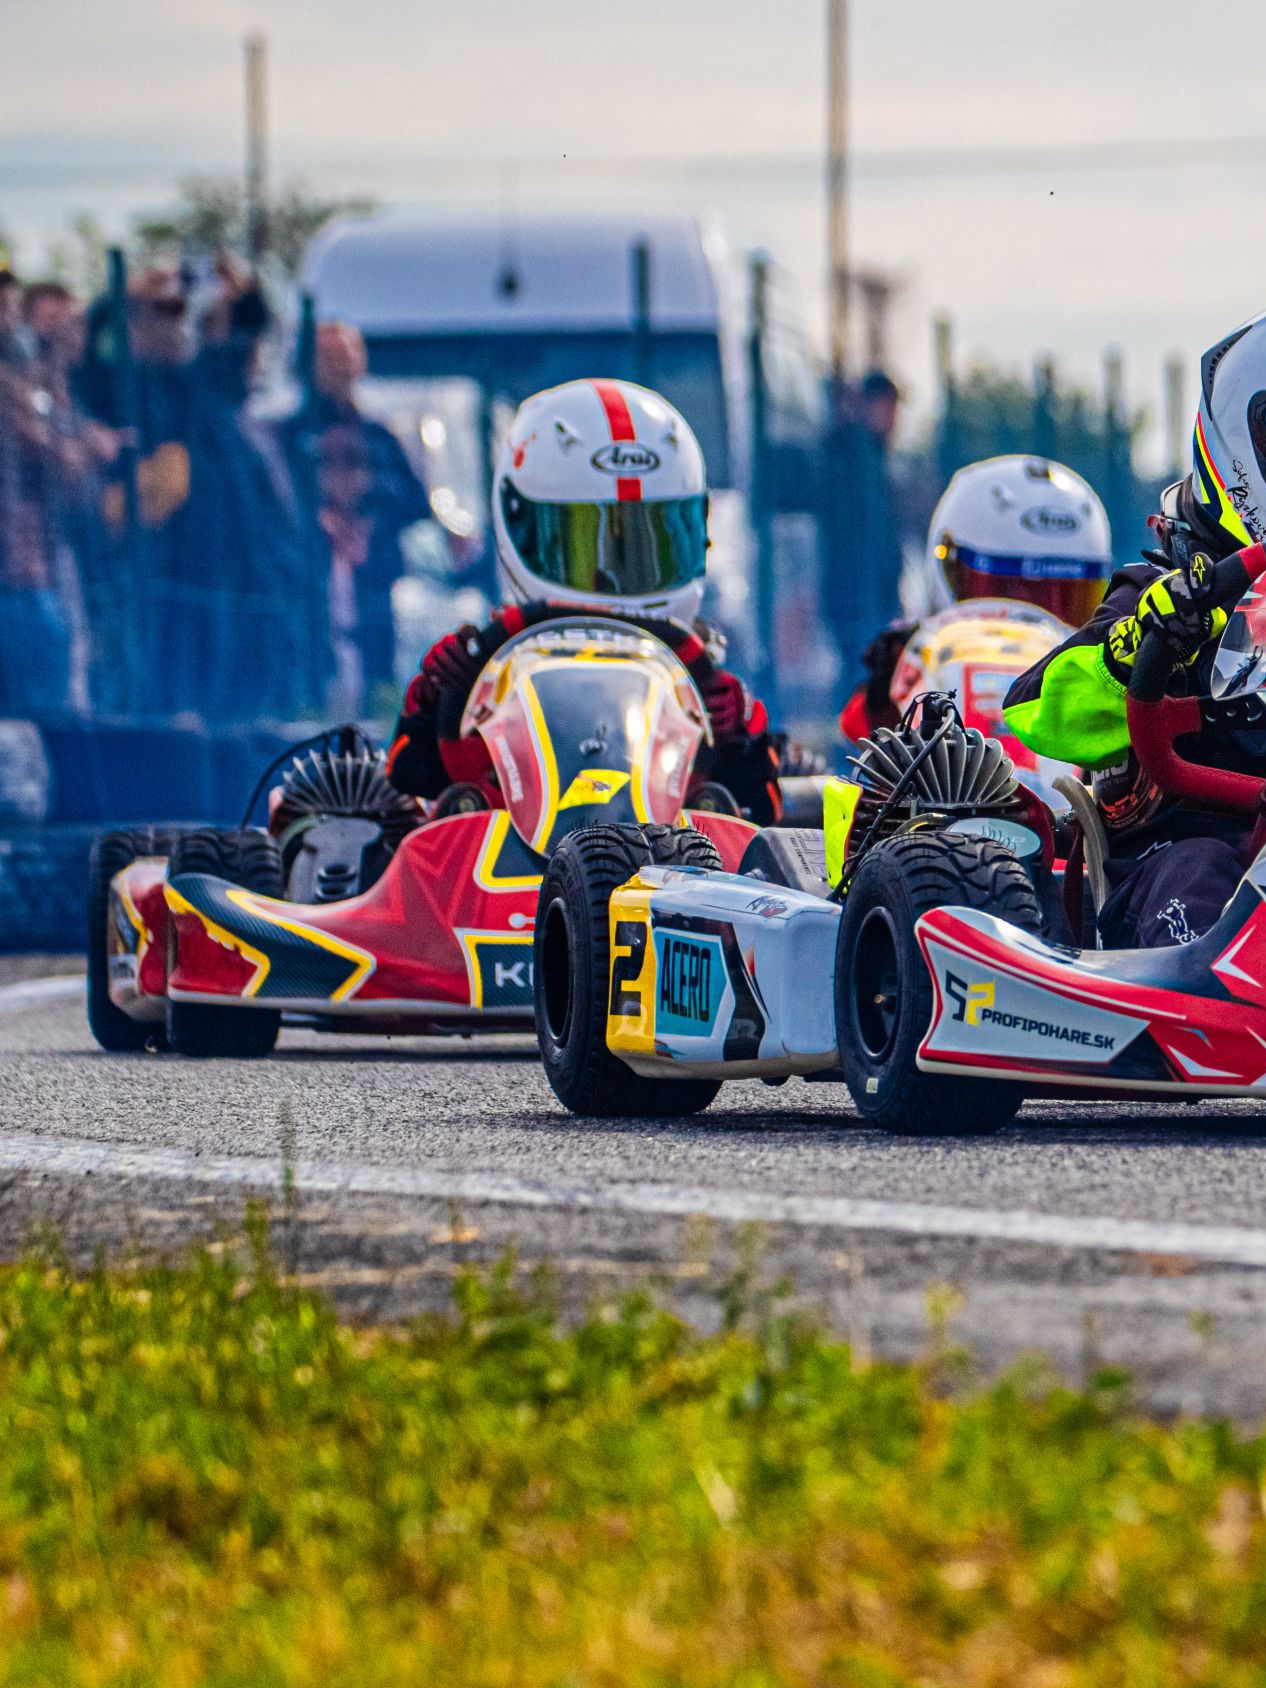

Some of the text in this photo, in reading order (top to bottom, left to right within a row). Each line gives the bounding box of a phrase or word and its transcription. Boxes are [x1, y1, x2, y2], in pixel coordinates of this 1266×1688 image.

[610, 921, 647, 1017] 2
[661, 938, 711, 1022] ACERO
[981, 1008, 1116, 1051] PROFIPOHARE.SK
